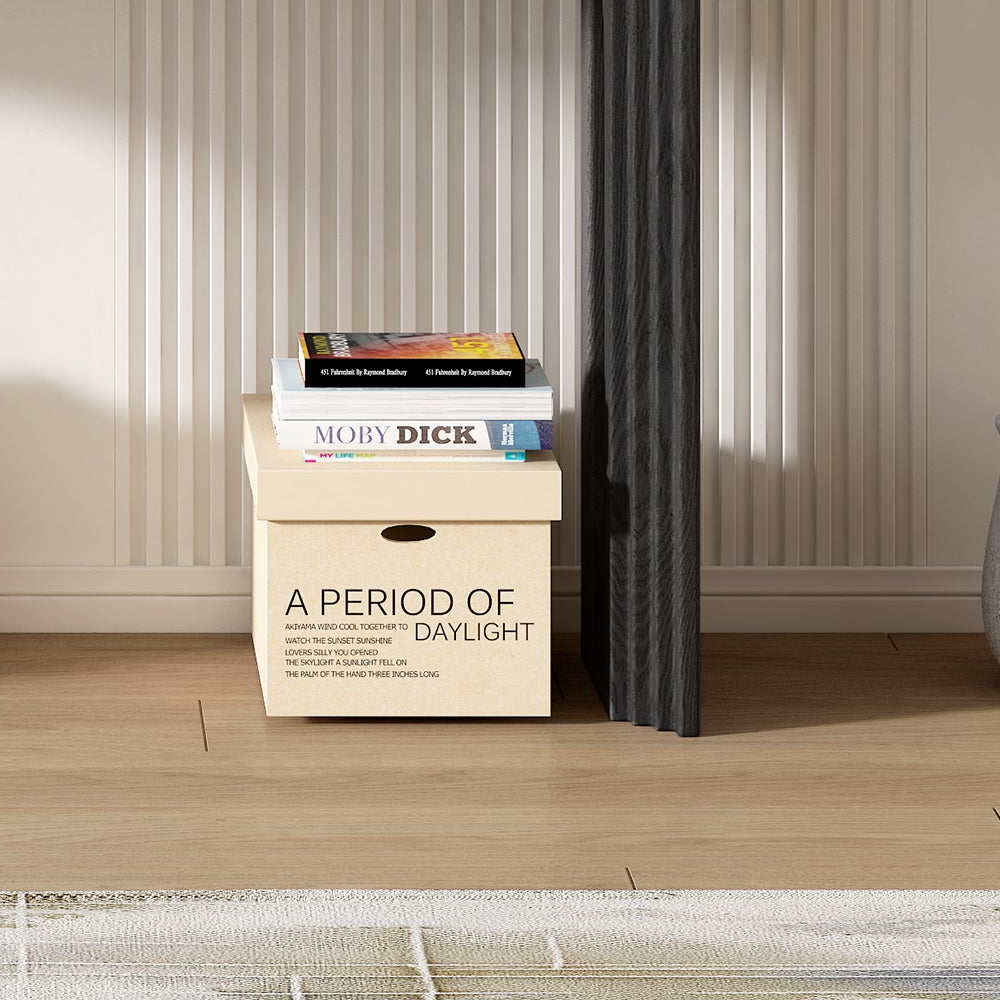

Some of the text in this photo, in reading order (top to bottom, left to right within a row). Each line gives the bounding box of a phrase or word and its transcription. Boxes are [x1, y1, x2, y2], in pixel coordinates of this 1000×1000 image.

[314, 425, 476, 444] MOBY DICK
[285, 589, 514, 615] A PERIOD OF
[312, 637, 325, 645] THE
[328, 637, 355, 645] SUNSET
[356, 637, 392, 645] SUNSHINE
[416, 623, 534, 641] DAYLIGHT
